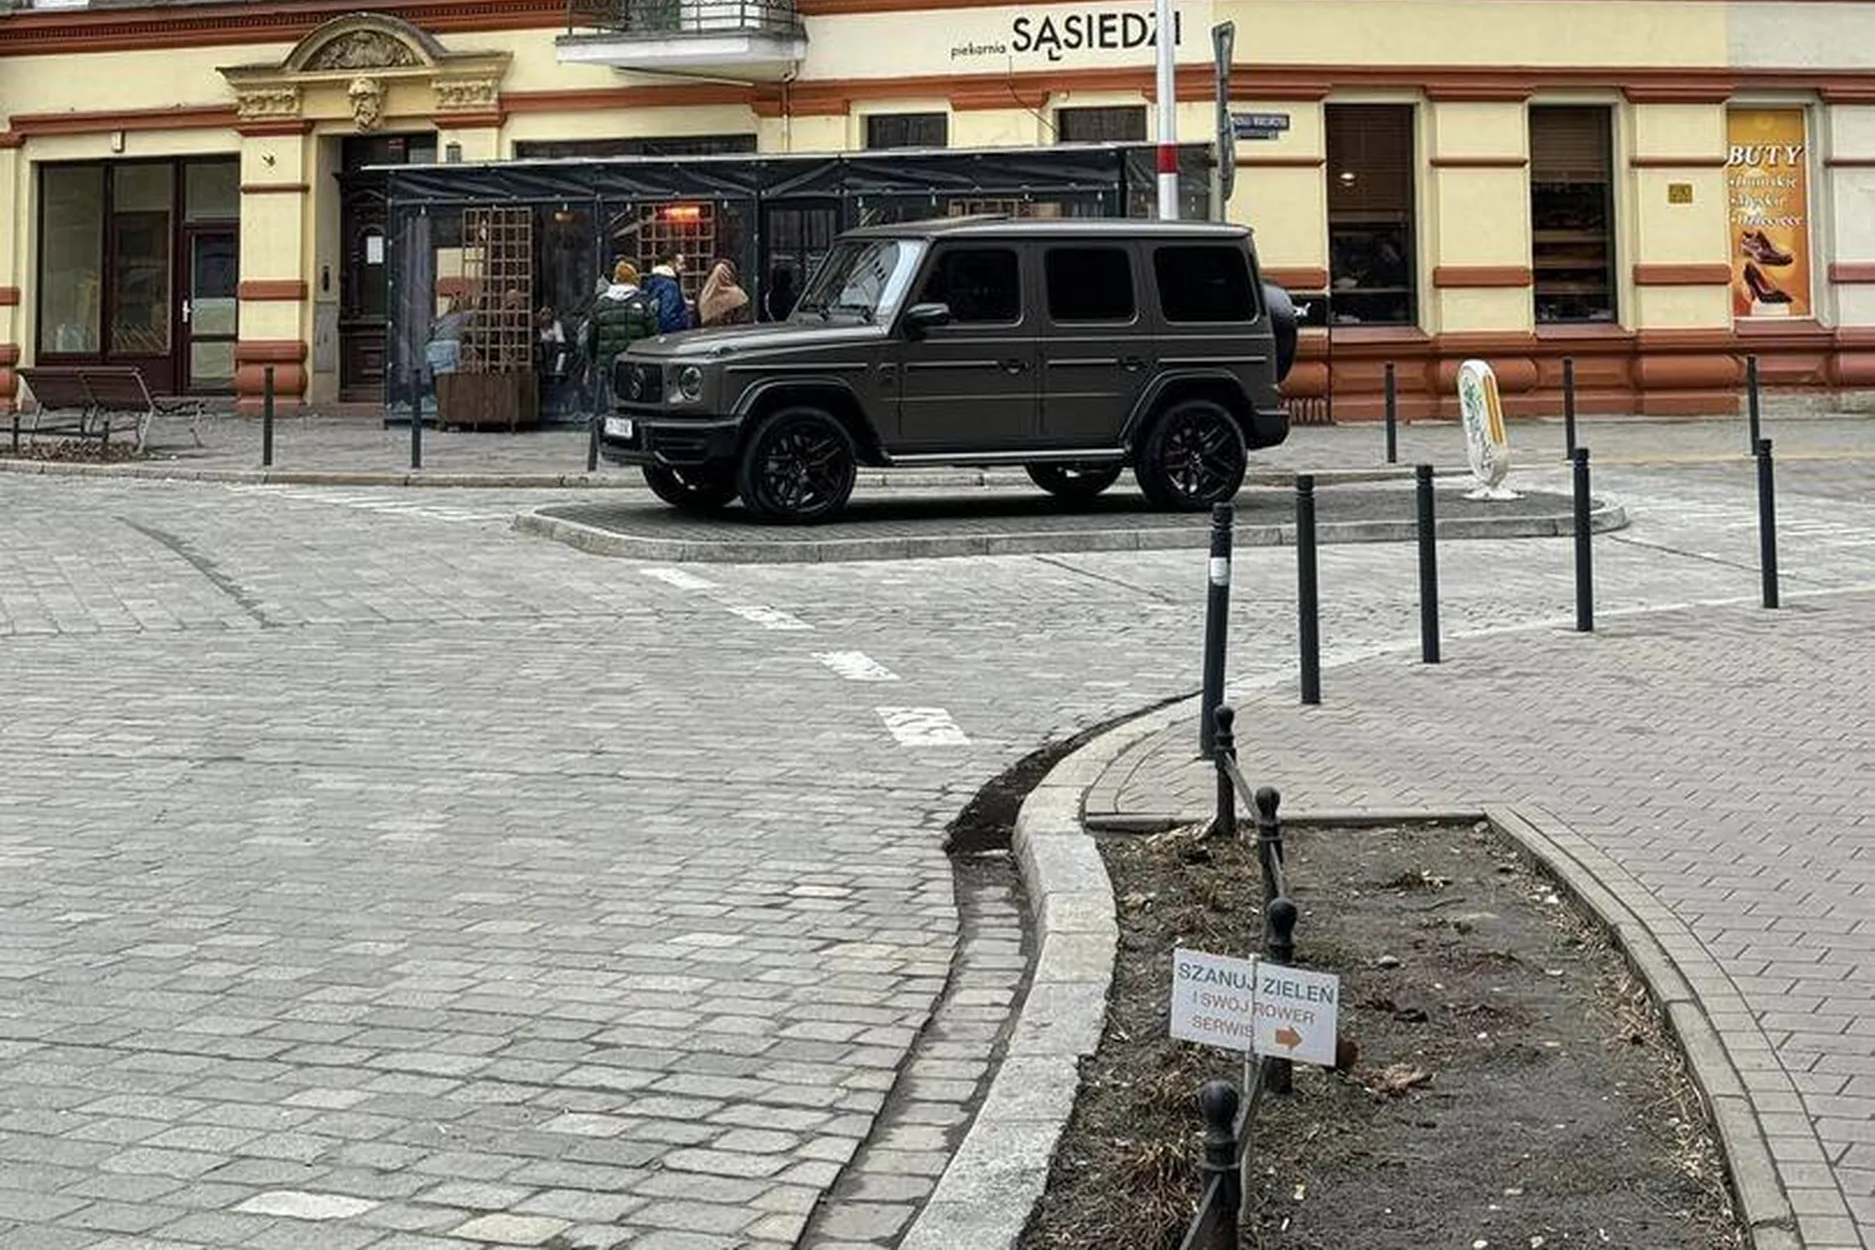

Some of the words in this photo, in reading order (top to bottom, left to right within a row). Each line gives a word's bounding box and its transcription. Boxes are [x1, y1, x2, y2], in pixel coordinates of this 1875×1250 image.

[1728, 145, 1802, 167] BUTY
[1178, 962, 1257, 991] SZANUJ
[1263, 978, 1334, 1005] ZIELEŃ
[1252, 1001, 1315, 1025] ROWER
